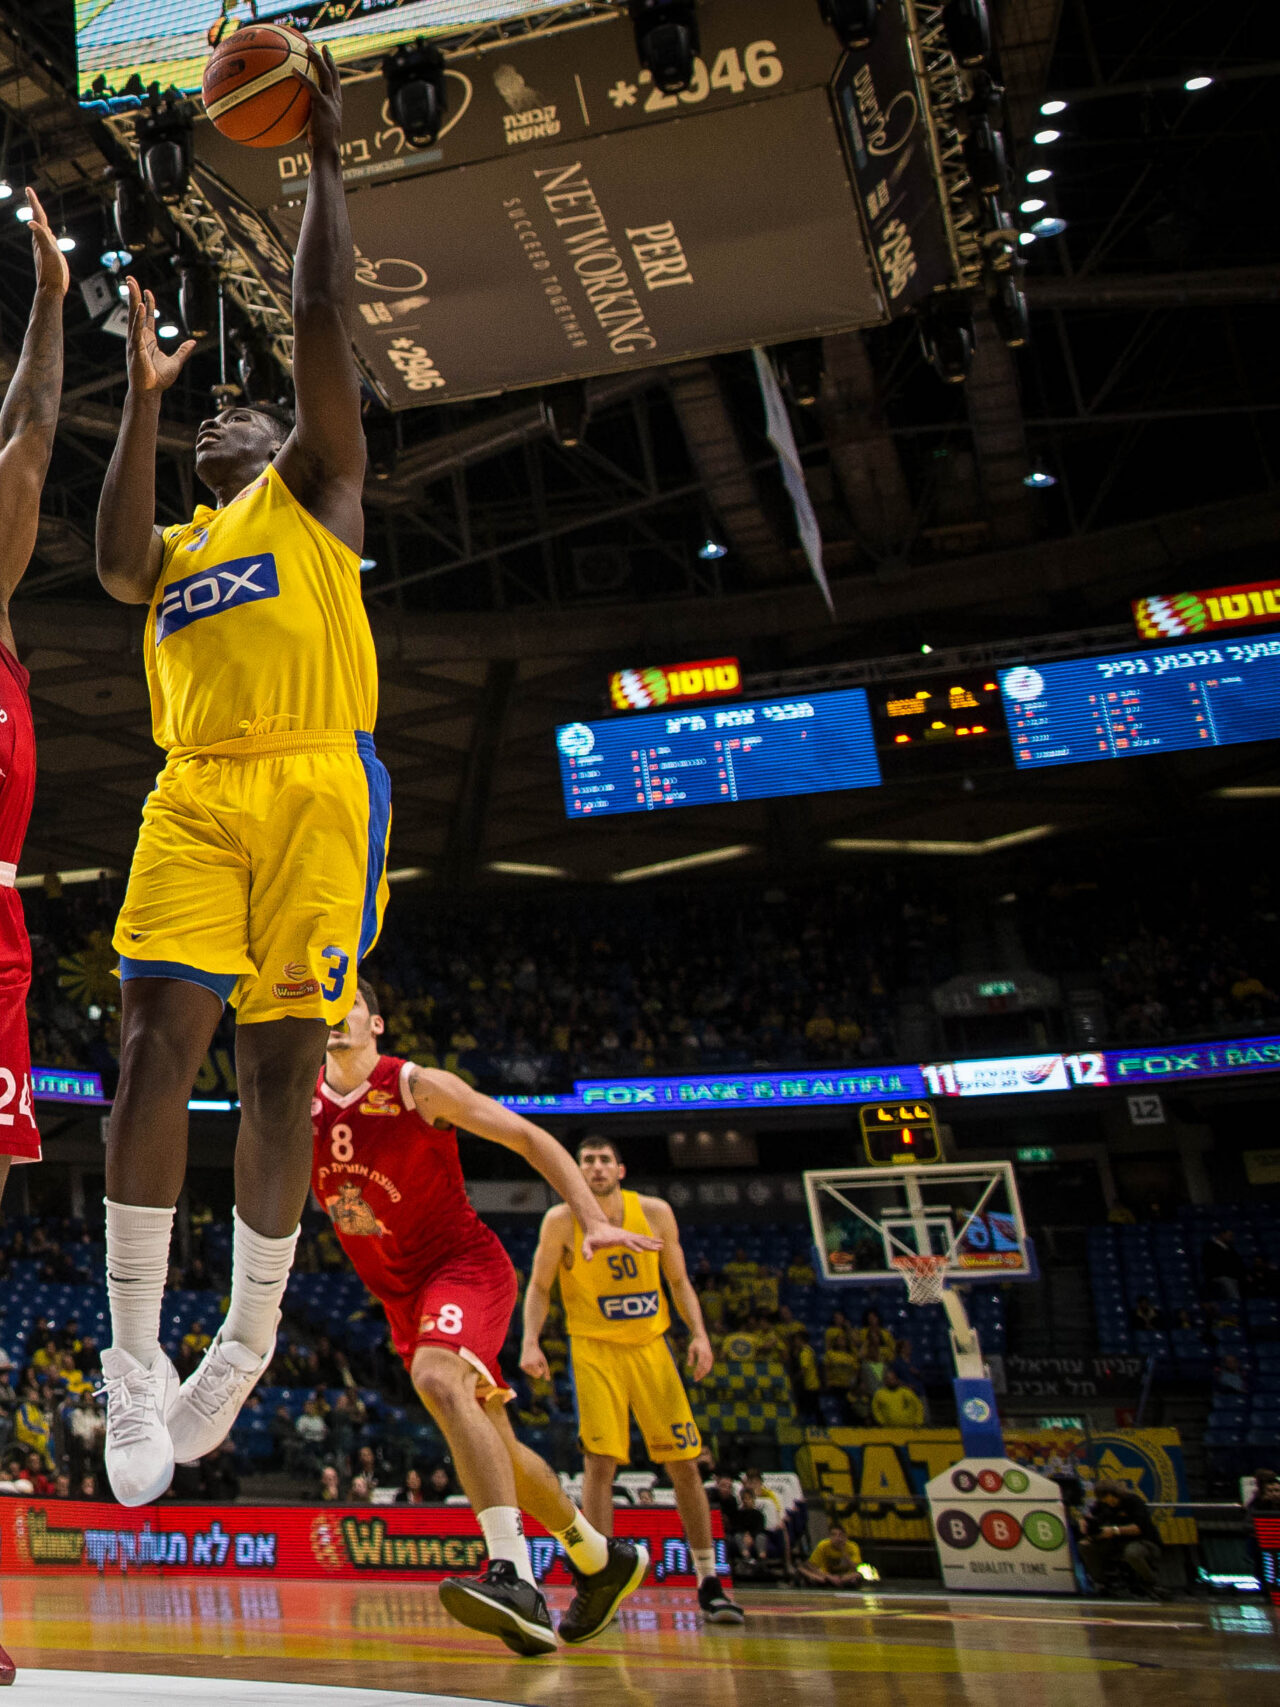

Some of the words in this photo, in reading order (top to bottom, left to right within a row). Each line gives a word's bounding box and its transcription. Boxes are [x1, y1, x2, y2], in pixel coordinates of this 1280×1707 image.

[532, 159, 658, 355] NETWORKING
[624, 219, 694, 292] PERI
[502, 196, 551, 271] SUCCEED
[540, 274, 588, 348] TOGETHER
[159, 562, 266, 620] FOX
[1095, 659, 1151, 679] גליל
[1152, 649, 1225, 676] גלבוע
[668, 664, 740, 697] טוטו
[319, 944, 350, 1003] 3
[921, 1064, 958, 1095] 11
[1065, 1052, 1106, 1085] 12
[1117, 1052, 1201, 1076] FOX
[583, 1086, 656, 1105] FOX
[678, 1081, 746, 1102] BASIC
[752, 1080, 775, 1099] IS
[779, 1074, 910, 1098] BEAUTIFUL
[1132, 1101, 1161, 1119] 12
[331, 1123, 354, 1163] 8
[607, 1253, 638, 1281] 50
[436, 1303, 463, 1335] 8
[603, 1294, 659, 1319] FOX
[1091, 1358, 1141, 1377] קניון
[1010, 1380, 1059, 1396] אביב
[1064, 1376, 1097, 1396] תל
[671, 1422, 699, 1449] 50
[808, 1441, 965, 1512] GAT
[191, 1520, 231, 1567] לא
[342, 1517, 486, 1568] Winner
[949, 1518, 968, 1541] B
[992, 1518, 1010, 1541] B
[1036, 1519, 1054, 1542] B
[235, 1532, 277, 1567] אם
[970, 1561, 1016, 1575] QUALITY
[1020, 1562, 1048, 1576] TIME
